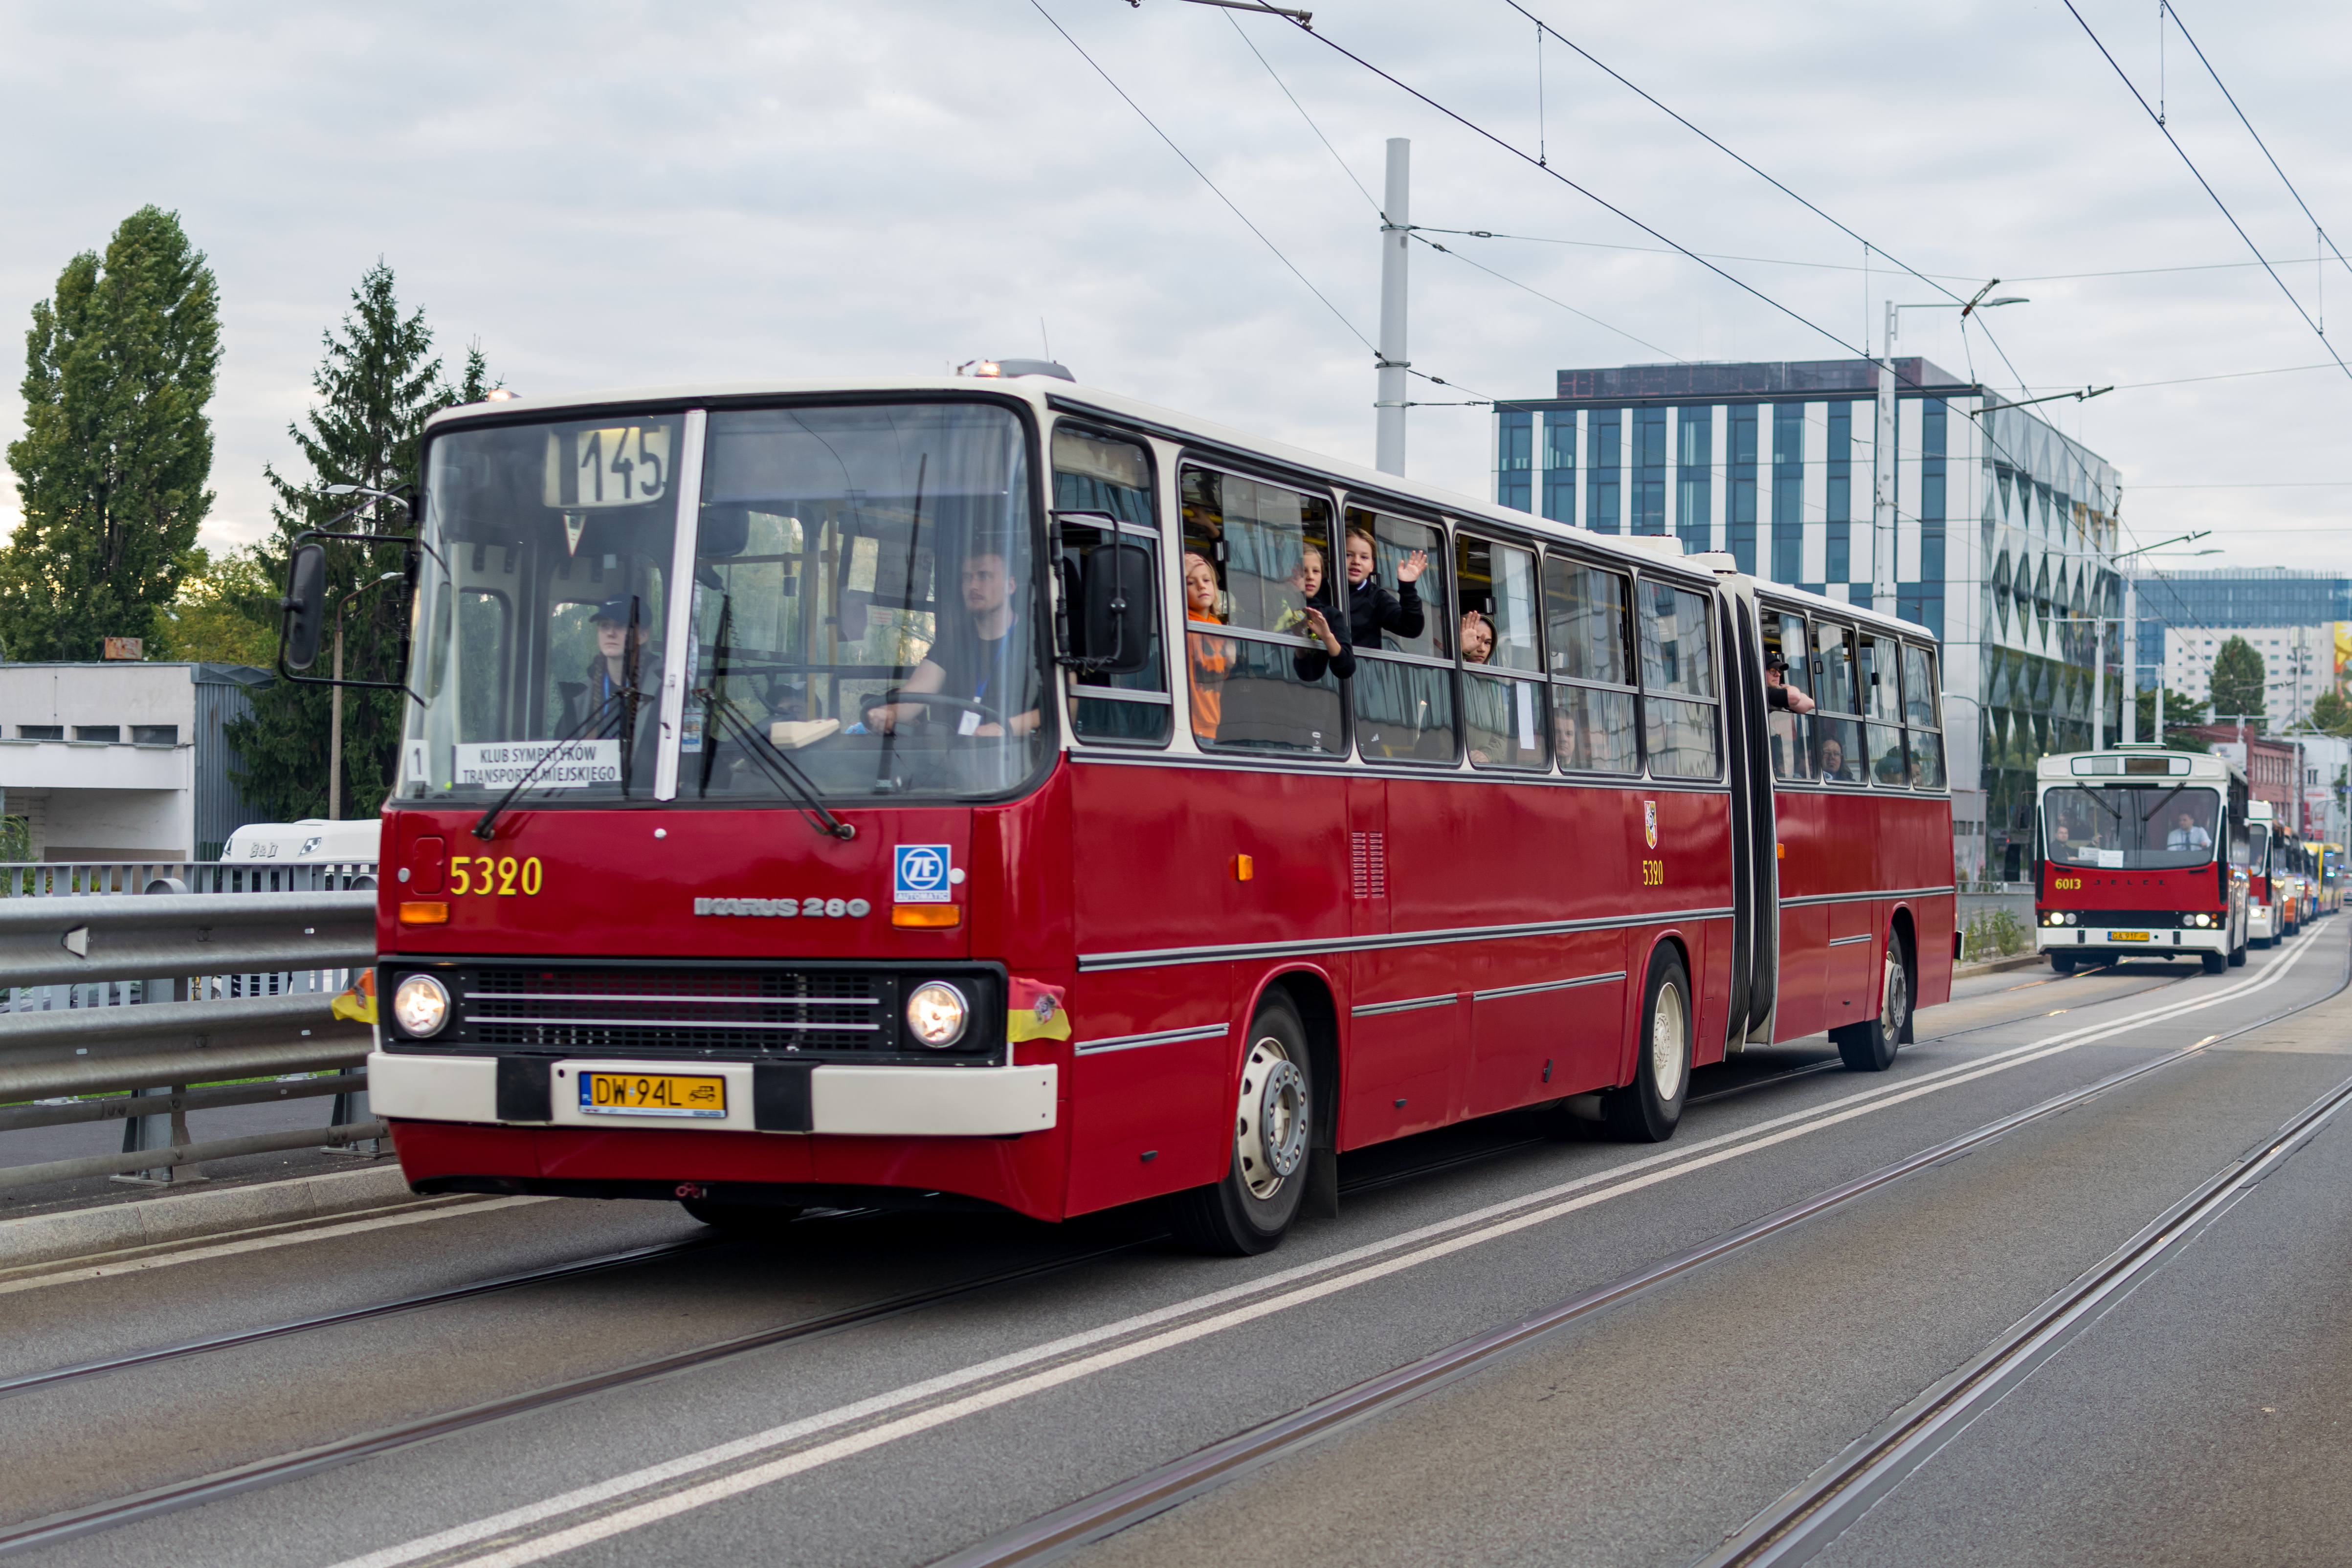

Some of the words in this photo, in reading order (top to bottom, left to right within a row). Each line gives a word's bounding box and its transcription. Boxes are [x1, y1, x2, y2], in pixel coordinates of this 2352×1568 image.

[580, 426, 663, 502] 145
[413, 747, 422, 775] 1
[480, 749, 509, 763] KLUB
[512, 744, 597, 763] SYMPATYKÓW
[542, 766, 616, 782] MIEJSKIEGO
[2055, 878, 2082, 890] 6013
[694, 898, 799, 917] IKARUS
[802, 898, 870, 918] 280
[596, 1078, 627, 1104] DW
[637, 1079, 683, 1106] 94L
